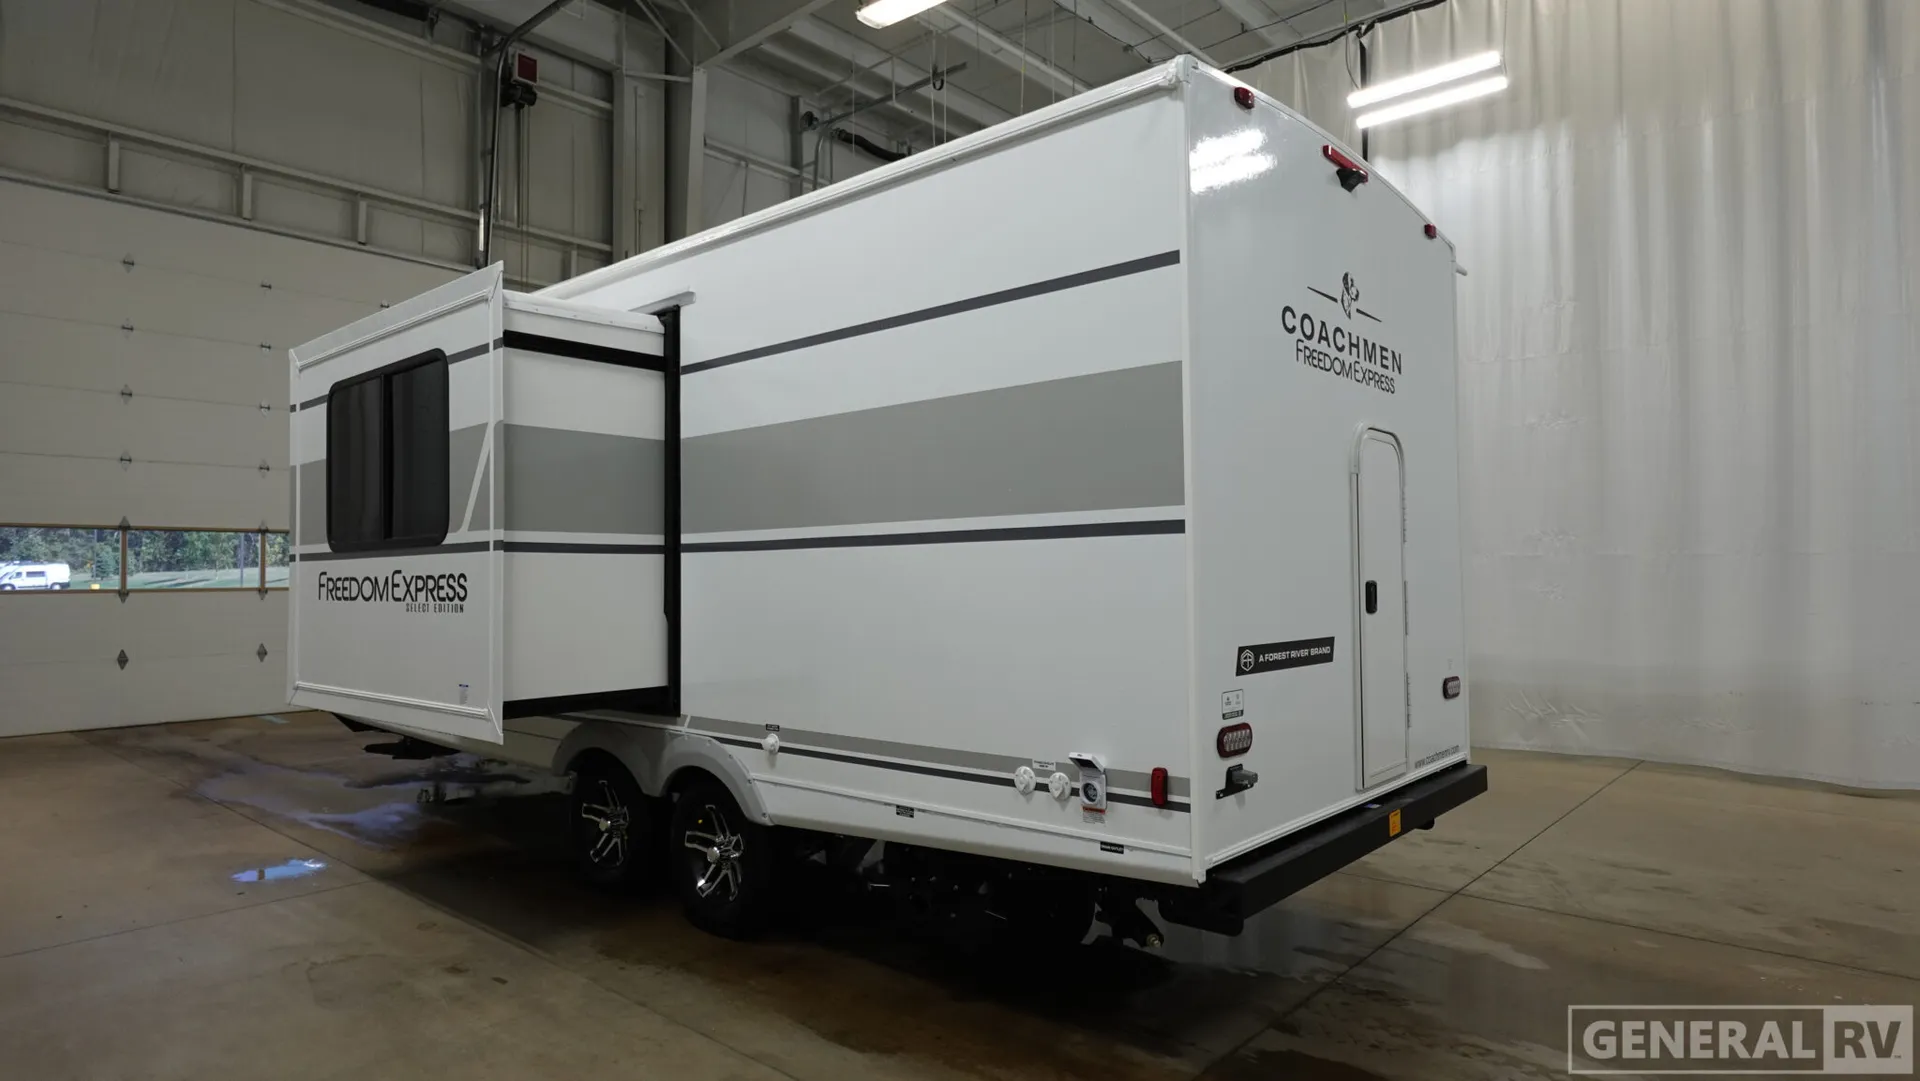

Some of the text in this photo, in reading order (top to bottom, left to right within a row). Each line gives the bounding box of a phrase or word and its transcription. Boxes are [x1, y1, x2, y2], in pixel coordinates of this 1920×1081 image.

[1281, 305, 1402, 375] COACHMEN
[405, 603, 464, 613] SELECT EDITION
[1258, 646, 1331, 663] A FOREST RIVER BRAND
